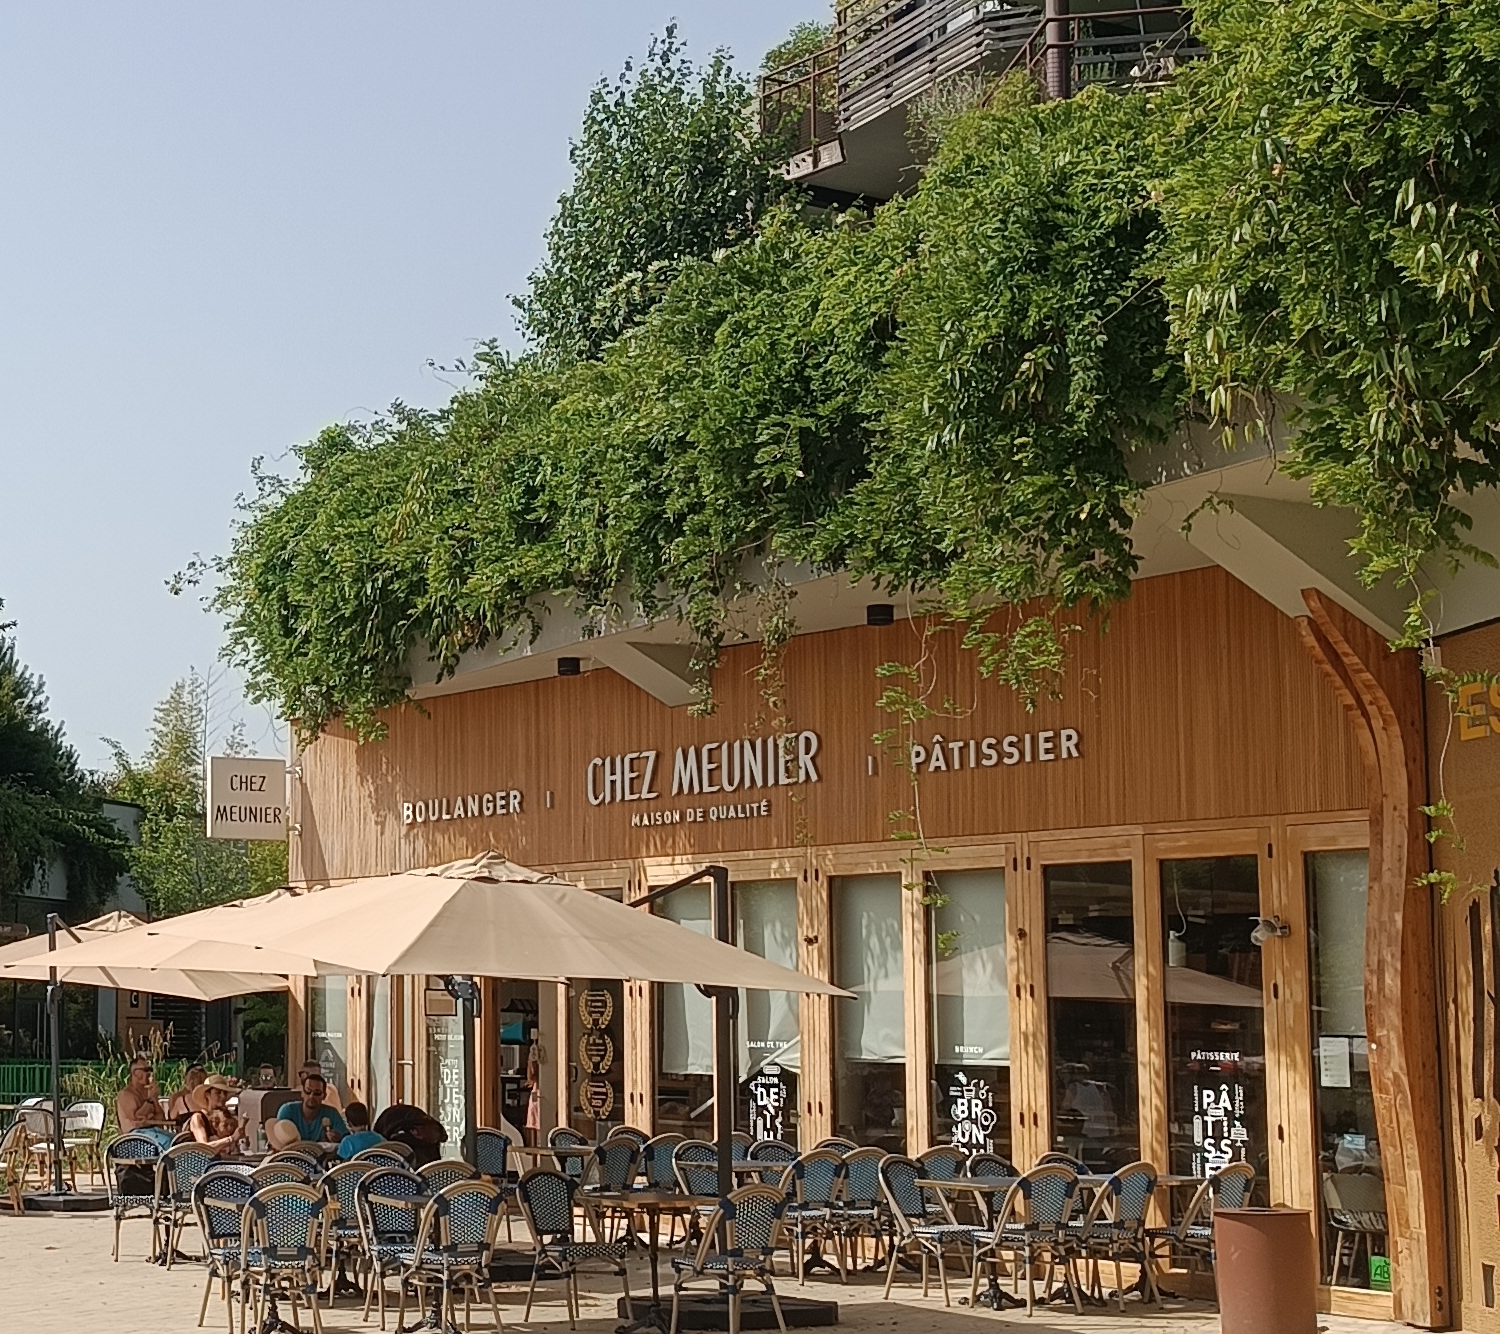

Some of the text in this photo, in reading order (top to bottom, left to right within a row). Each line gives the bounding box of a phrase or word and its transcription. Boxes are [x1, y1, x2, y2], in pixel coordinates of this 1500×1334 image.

[911, 728, 1080, 773] PÂTISSIER
[587, 730, 819, 806] CHEZ MEUNIER
[230, 774, 267, 792] CHEZ
[215, 805, 282, 825] MEUNIER
[403, 789, 522, 824] BOULANGER
[631, 798, 770, 827] MAISON DE QUALITÉ
[954, 1045, 984, 1054] BRUNCH
[1190, 1050, 1240, 1062] PÂTISSERIE
[757, 1087, 780, 1106] DE
